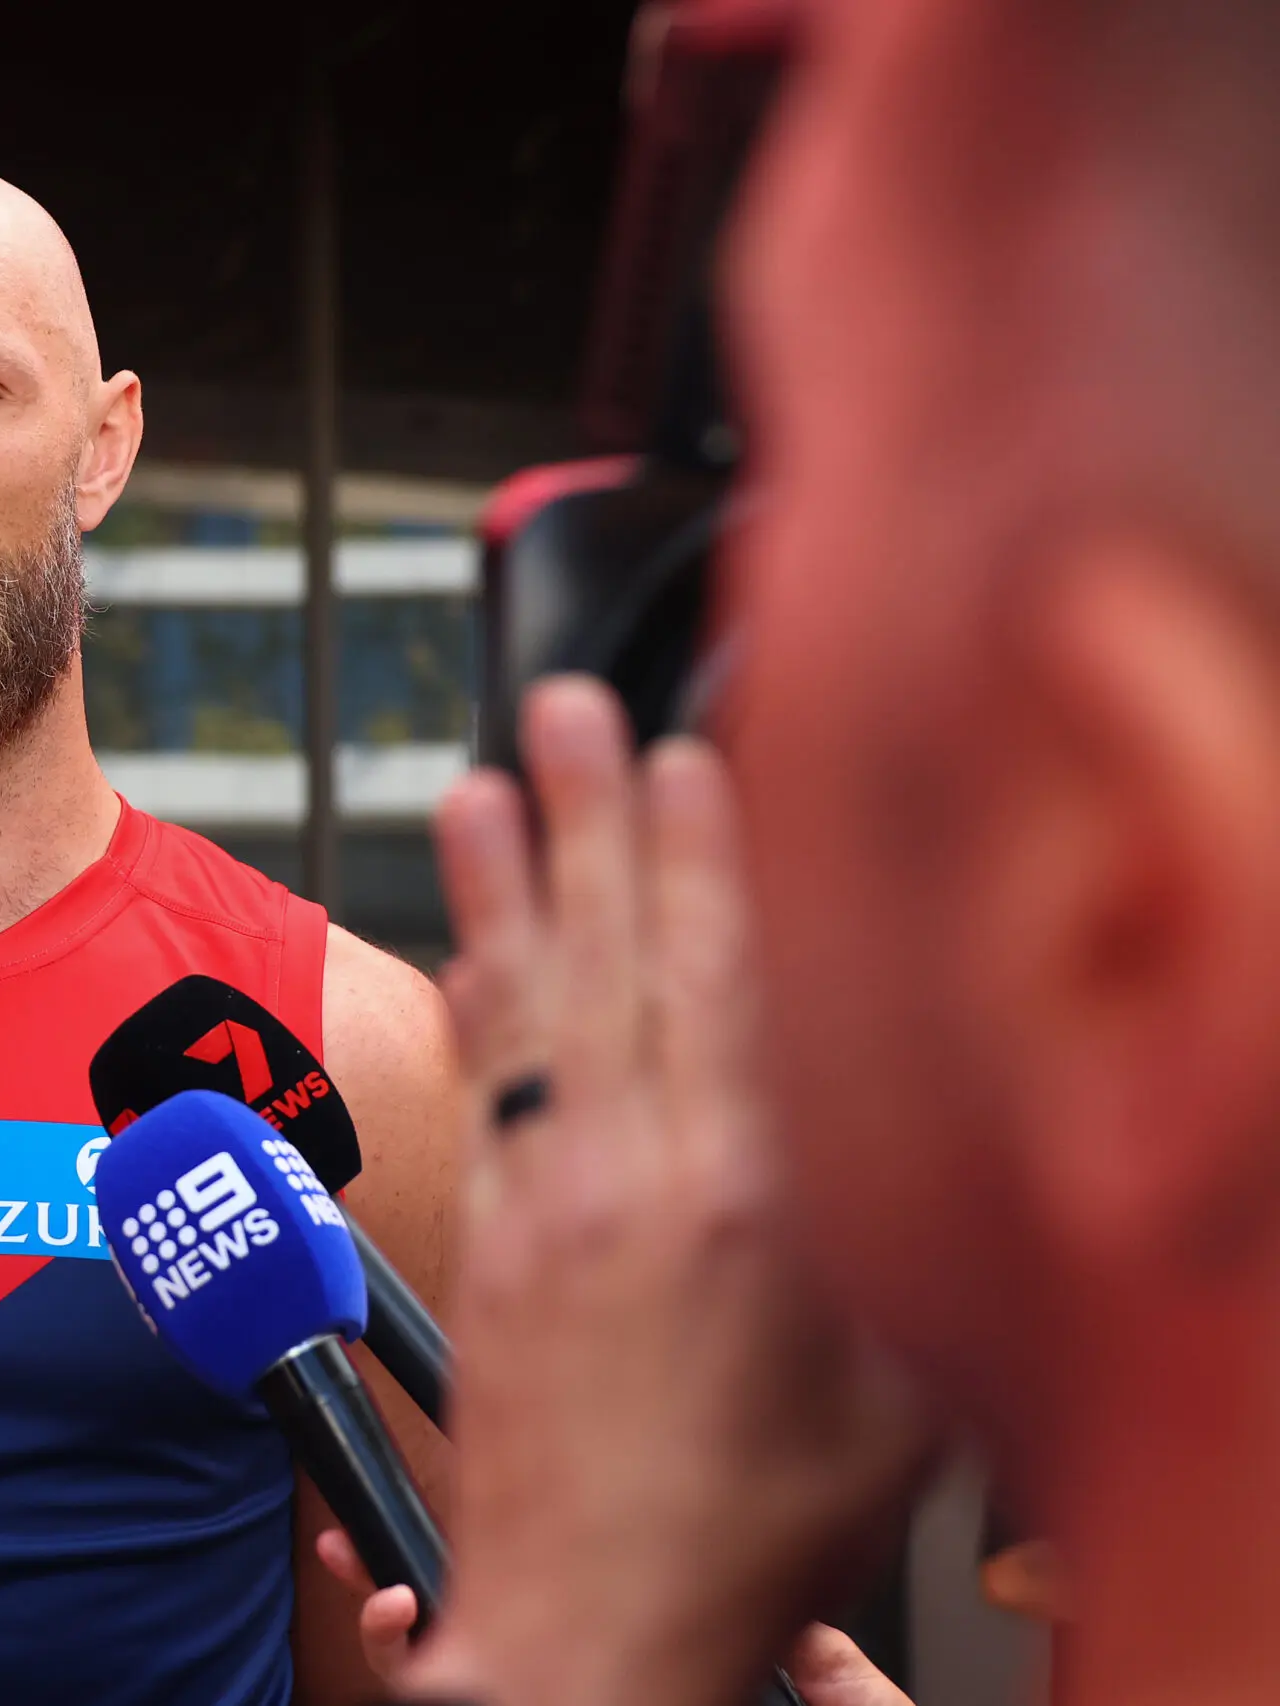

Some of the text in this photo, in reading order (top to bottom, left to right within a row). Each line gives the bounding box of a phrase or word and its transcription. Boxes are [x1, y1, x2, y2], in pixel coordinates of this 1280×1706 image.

[183, 1018, 274, 1104] 7
[175, 1151, 257, 1232] 9
[152, 1208, 280, 1310] NEWS
